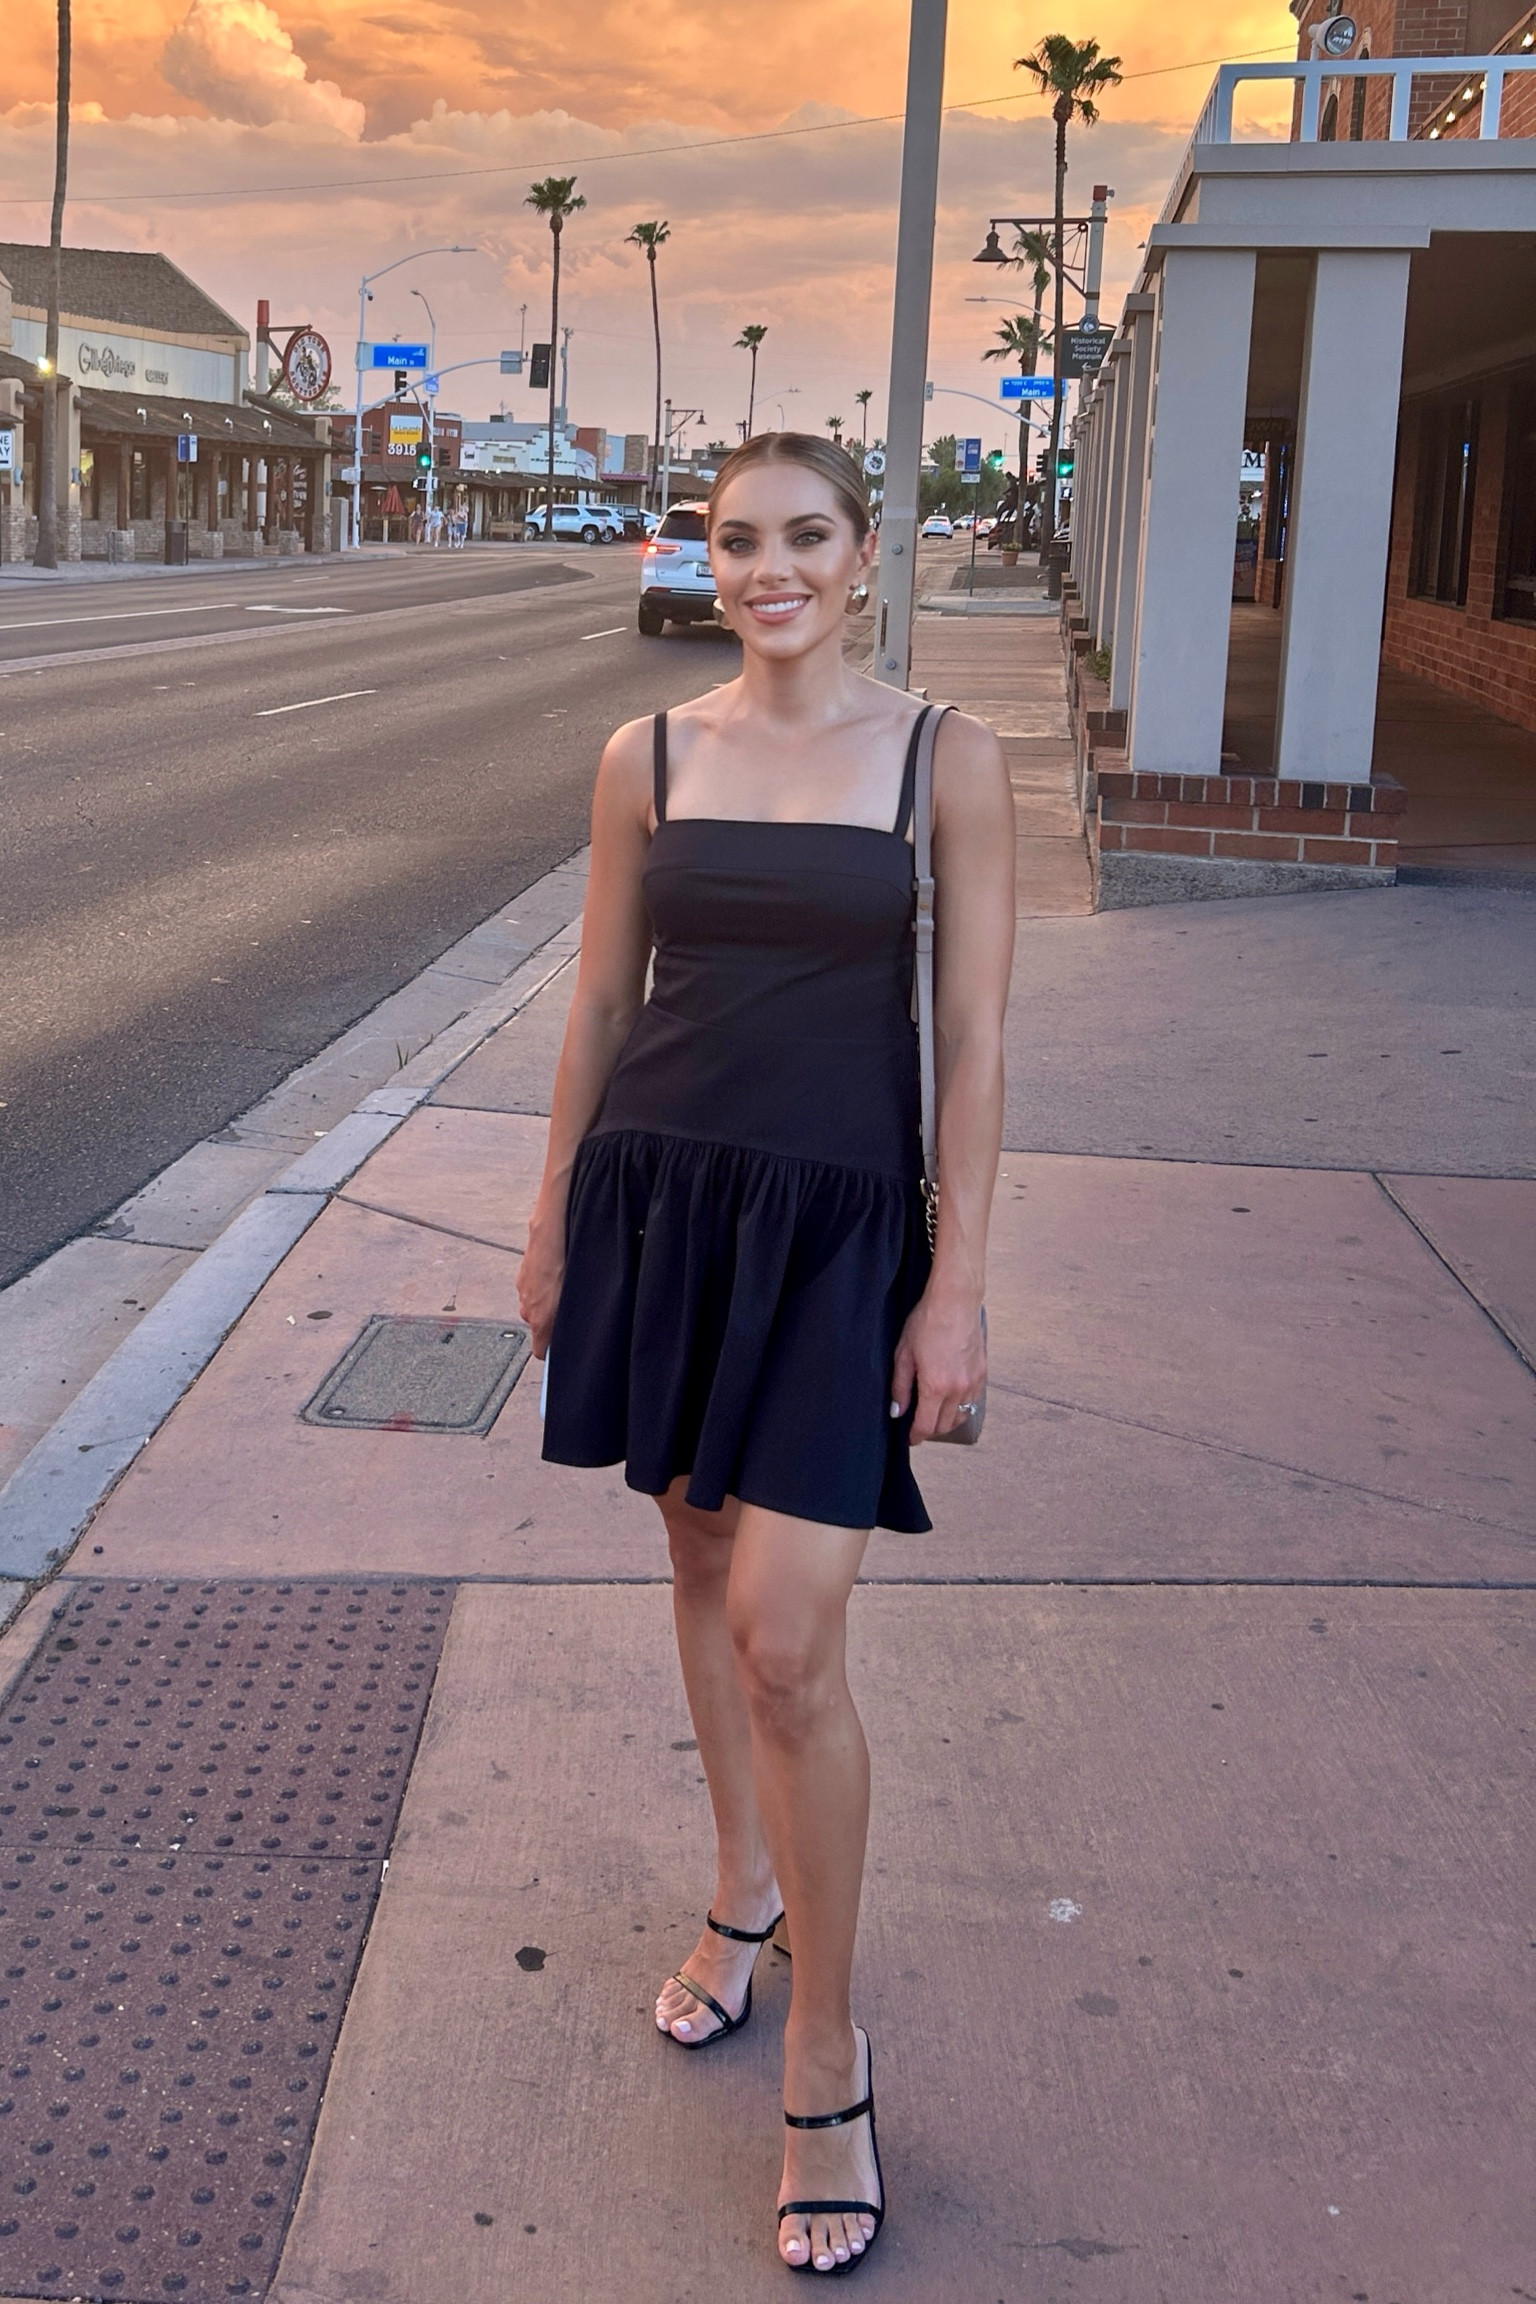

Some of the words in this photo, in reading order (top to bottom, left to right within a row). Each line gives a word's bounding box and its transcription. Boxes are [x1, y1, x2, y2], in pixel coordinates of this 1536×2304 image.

[1070, 337, 1106, 345] Historical
[1074, 345, 1102, 354] Society
[387, 355, 408, 366] Main
[1071, 352, 1103, 360] Museum
[1021, 387, 1041, 396] Main
